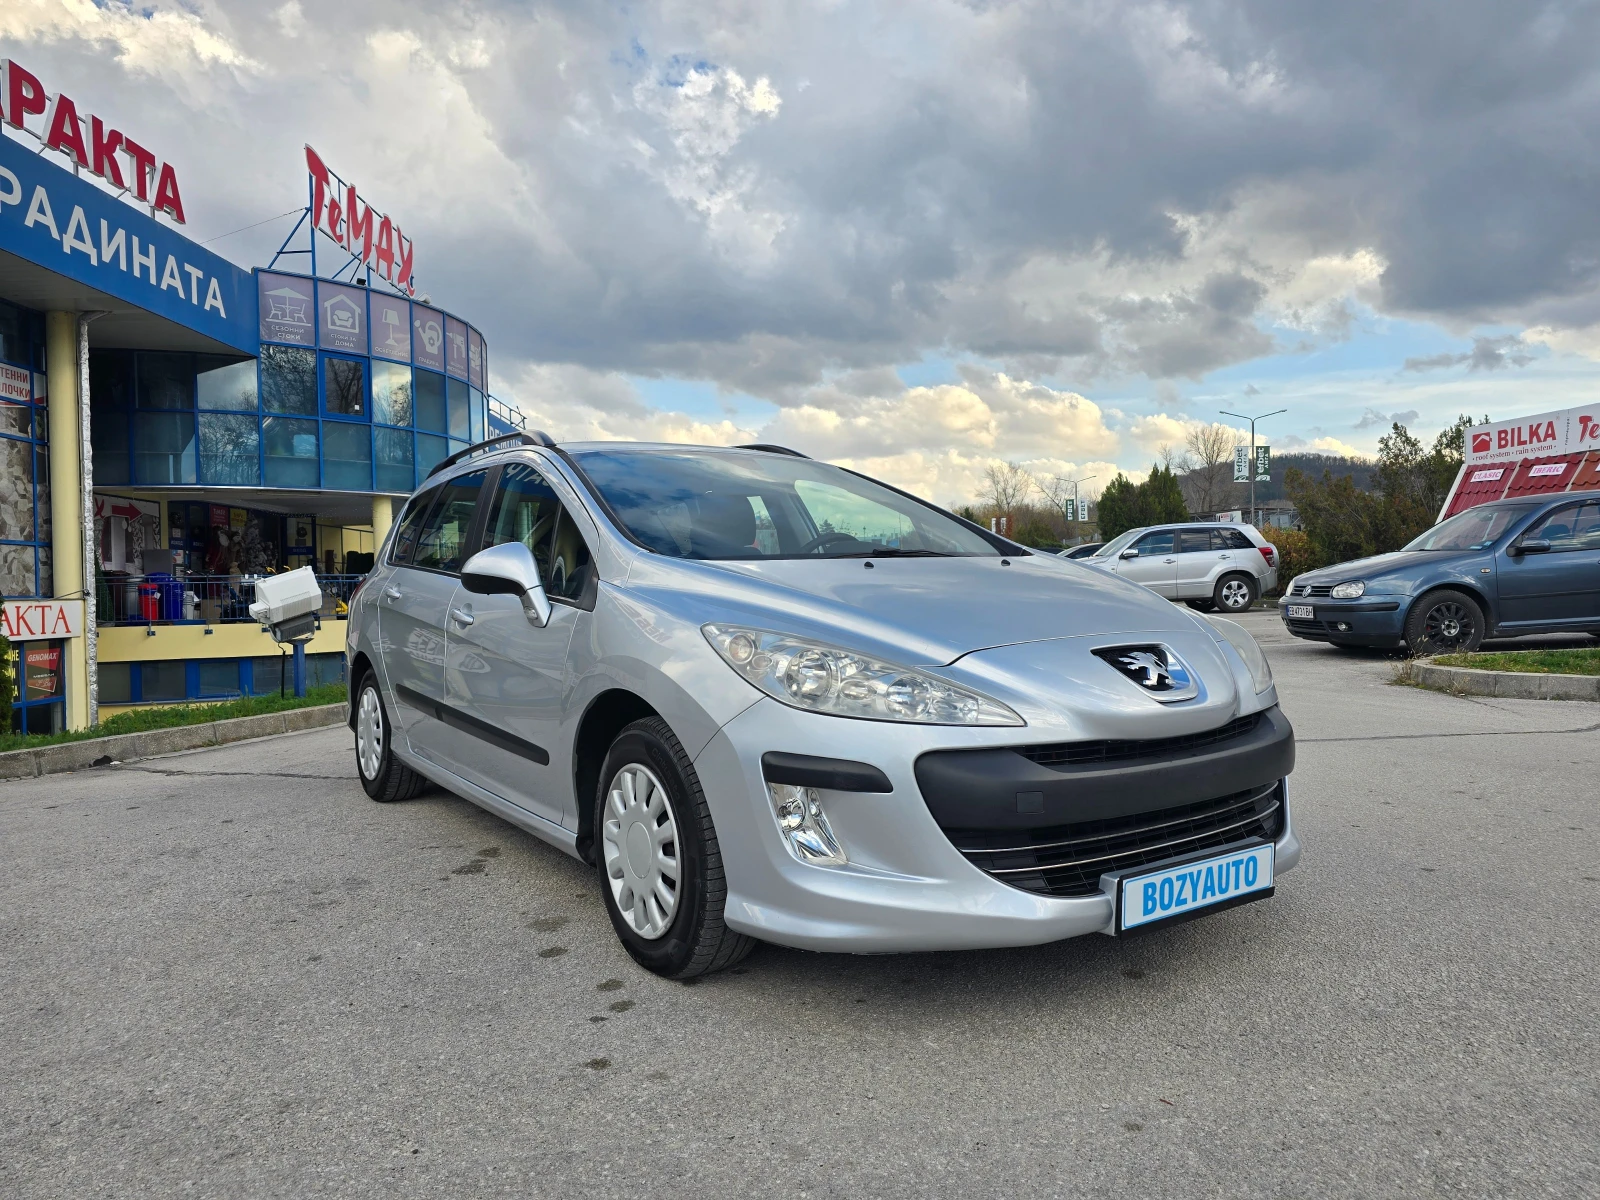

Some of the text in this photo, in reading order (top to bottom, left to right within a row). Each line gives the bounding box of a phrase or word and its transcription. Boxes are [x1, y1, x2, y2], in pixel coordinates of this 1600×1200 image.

[335, 340, 354, 348] ДОМА
[1498, 421, 1557, 449] BILKA
[1489, 450, 1511, 460] system
[1515, 447, 1529, 455] rain
[1530, 444, 1553, 454] system
[1533, 466, 1563, 474] IBERIC
[1473, 471, 1501, 480] CLASIC
[28, 652, 58, 662] GENOMAX
[1142, 855, 1258, 917] BOZYAUTO
